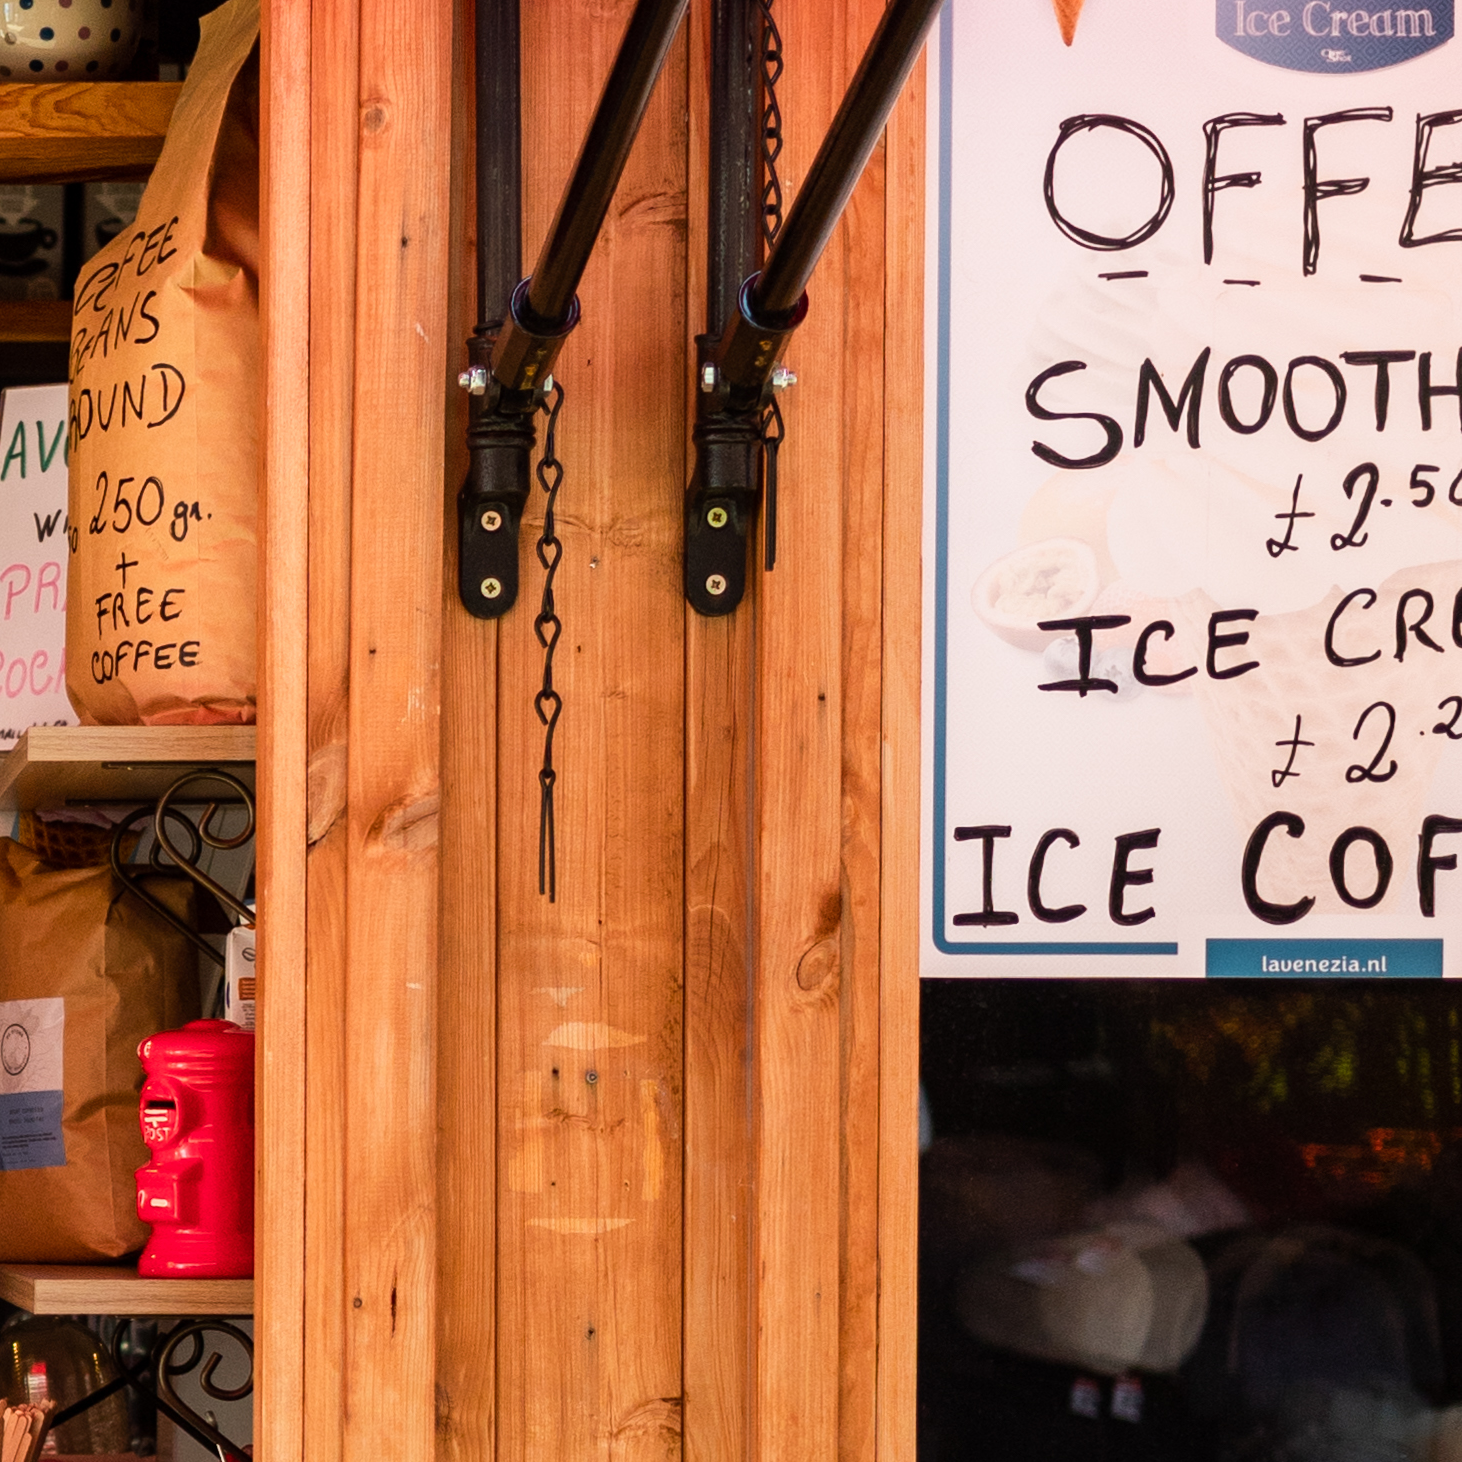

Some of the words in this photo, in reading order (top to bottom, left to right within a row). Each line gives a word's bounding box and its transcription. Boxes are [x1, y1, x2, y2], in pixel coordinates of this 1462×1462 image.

[1233, 0, 1291, 37] Ice
[1302, 0, 1437, 38] Cream
[1024, 346, 1462, 470] SMOOTH
[89, 470, 165, 536] 250
[94, 586, 186, 641] FREE
[1037, 608, 1260, 698] ICE
[1324, 588, 1462, 666] CR
[91, 639, 201, 685] COFFEE
[952, 825, 1162, 928] ICE
[1261, 955, 1388, 973] lavenezia.nl
